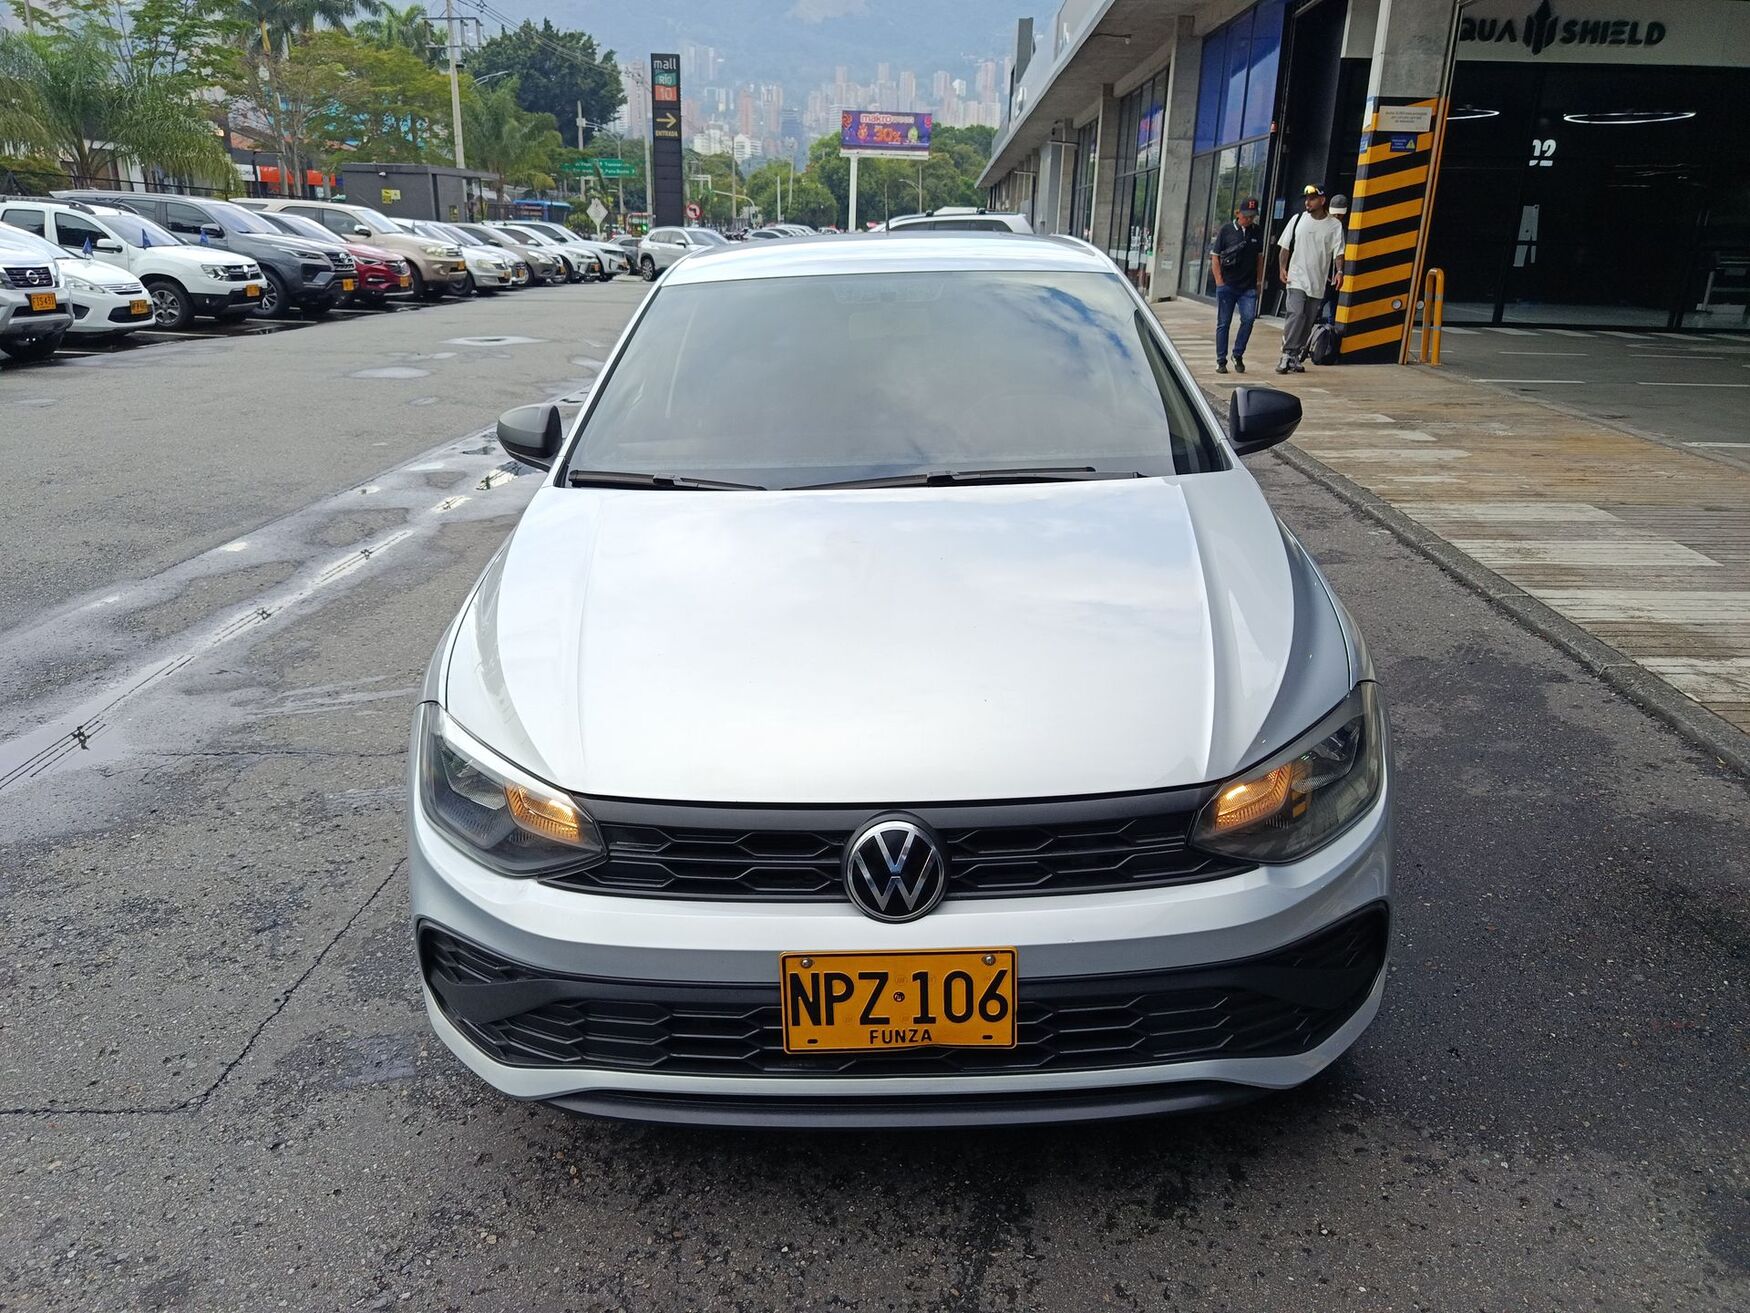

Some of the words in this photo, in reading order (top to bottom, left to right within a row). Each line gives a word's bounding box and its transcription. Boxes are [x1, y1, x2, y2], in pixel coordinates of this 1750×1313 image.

[1559, 19, 1666, 46] SHIELD
[653, 58, 677, 70] mall
[1248, 199, 1255, 209] H
[789, 971, 890, 1026] NPZ
[911, 969, 1009, 1024] 106
[869, 1028, 933, 1044] FUNZA
